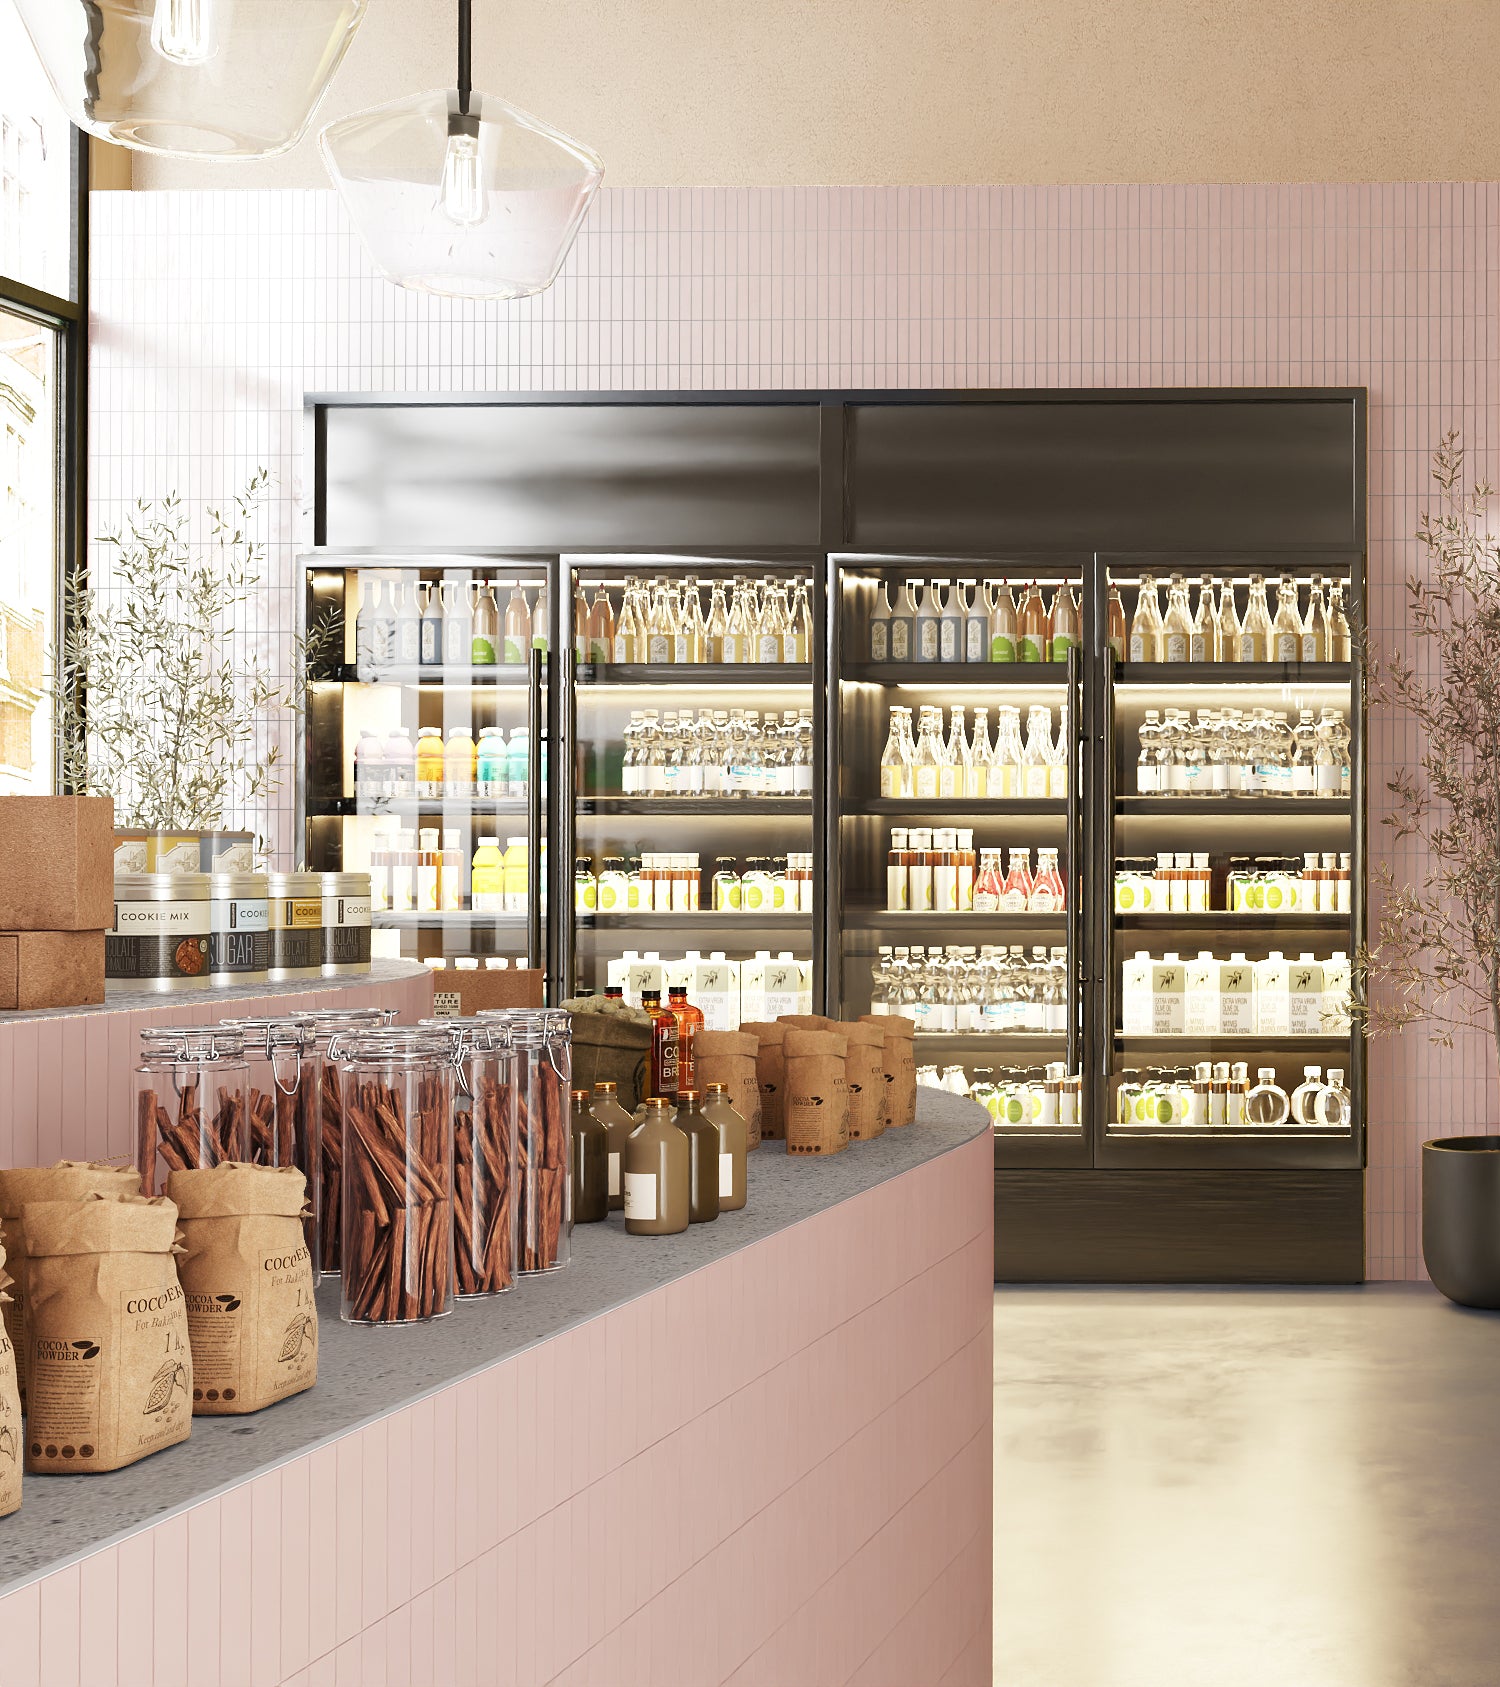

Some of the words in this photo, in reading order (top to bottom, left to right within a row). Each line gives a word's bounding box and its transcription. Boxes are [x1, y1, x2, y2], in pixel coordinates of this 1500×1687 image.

[121, 912, 166, 921] COOKIE
[169, 912, 190, 921] MIX
[210, 934, 253, 965] SUGAR
[185, 1294, 213, 1304] COCOA
[37, 1340, 69, 1351] COCOA
[37, 1351, 79, 1361] POWDER
